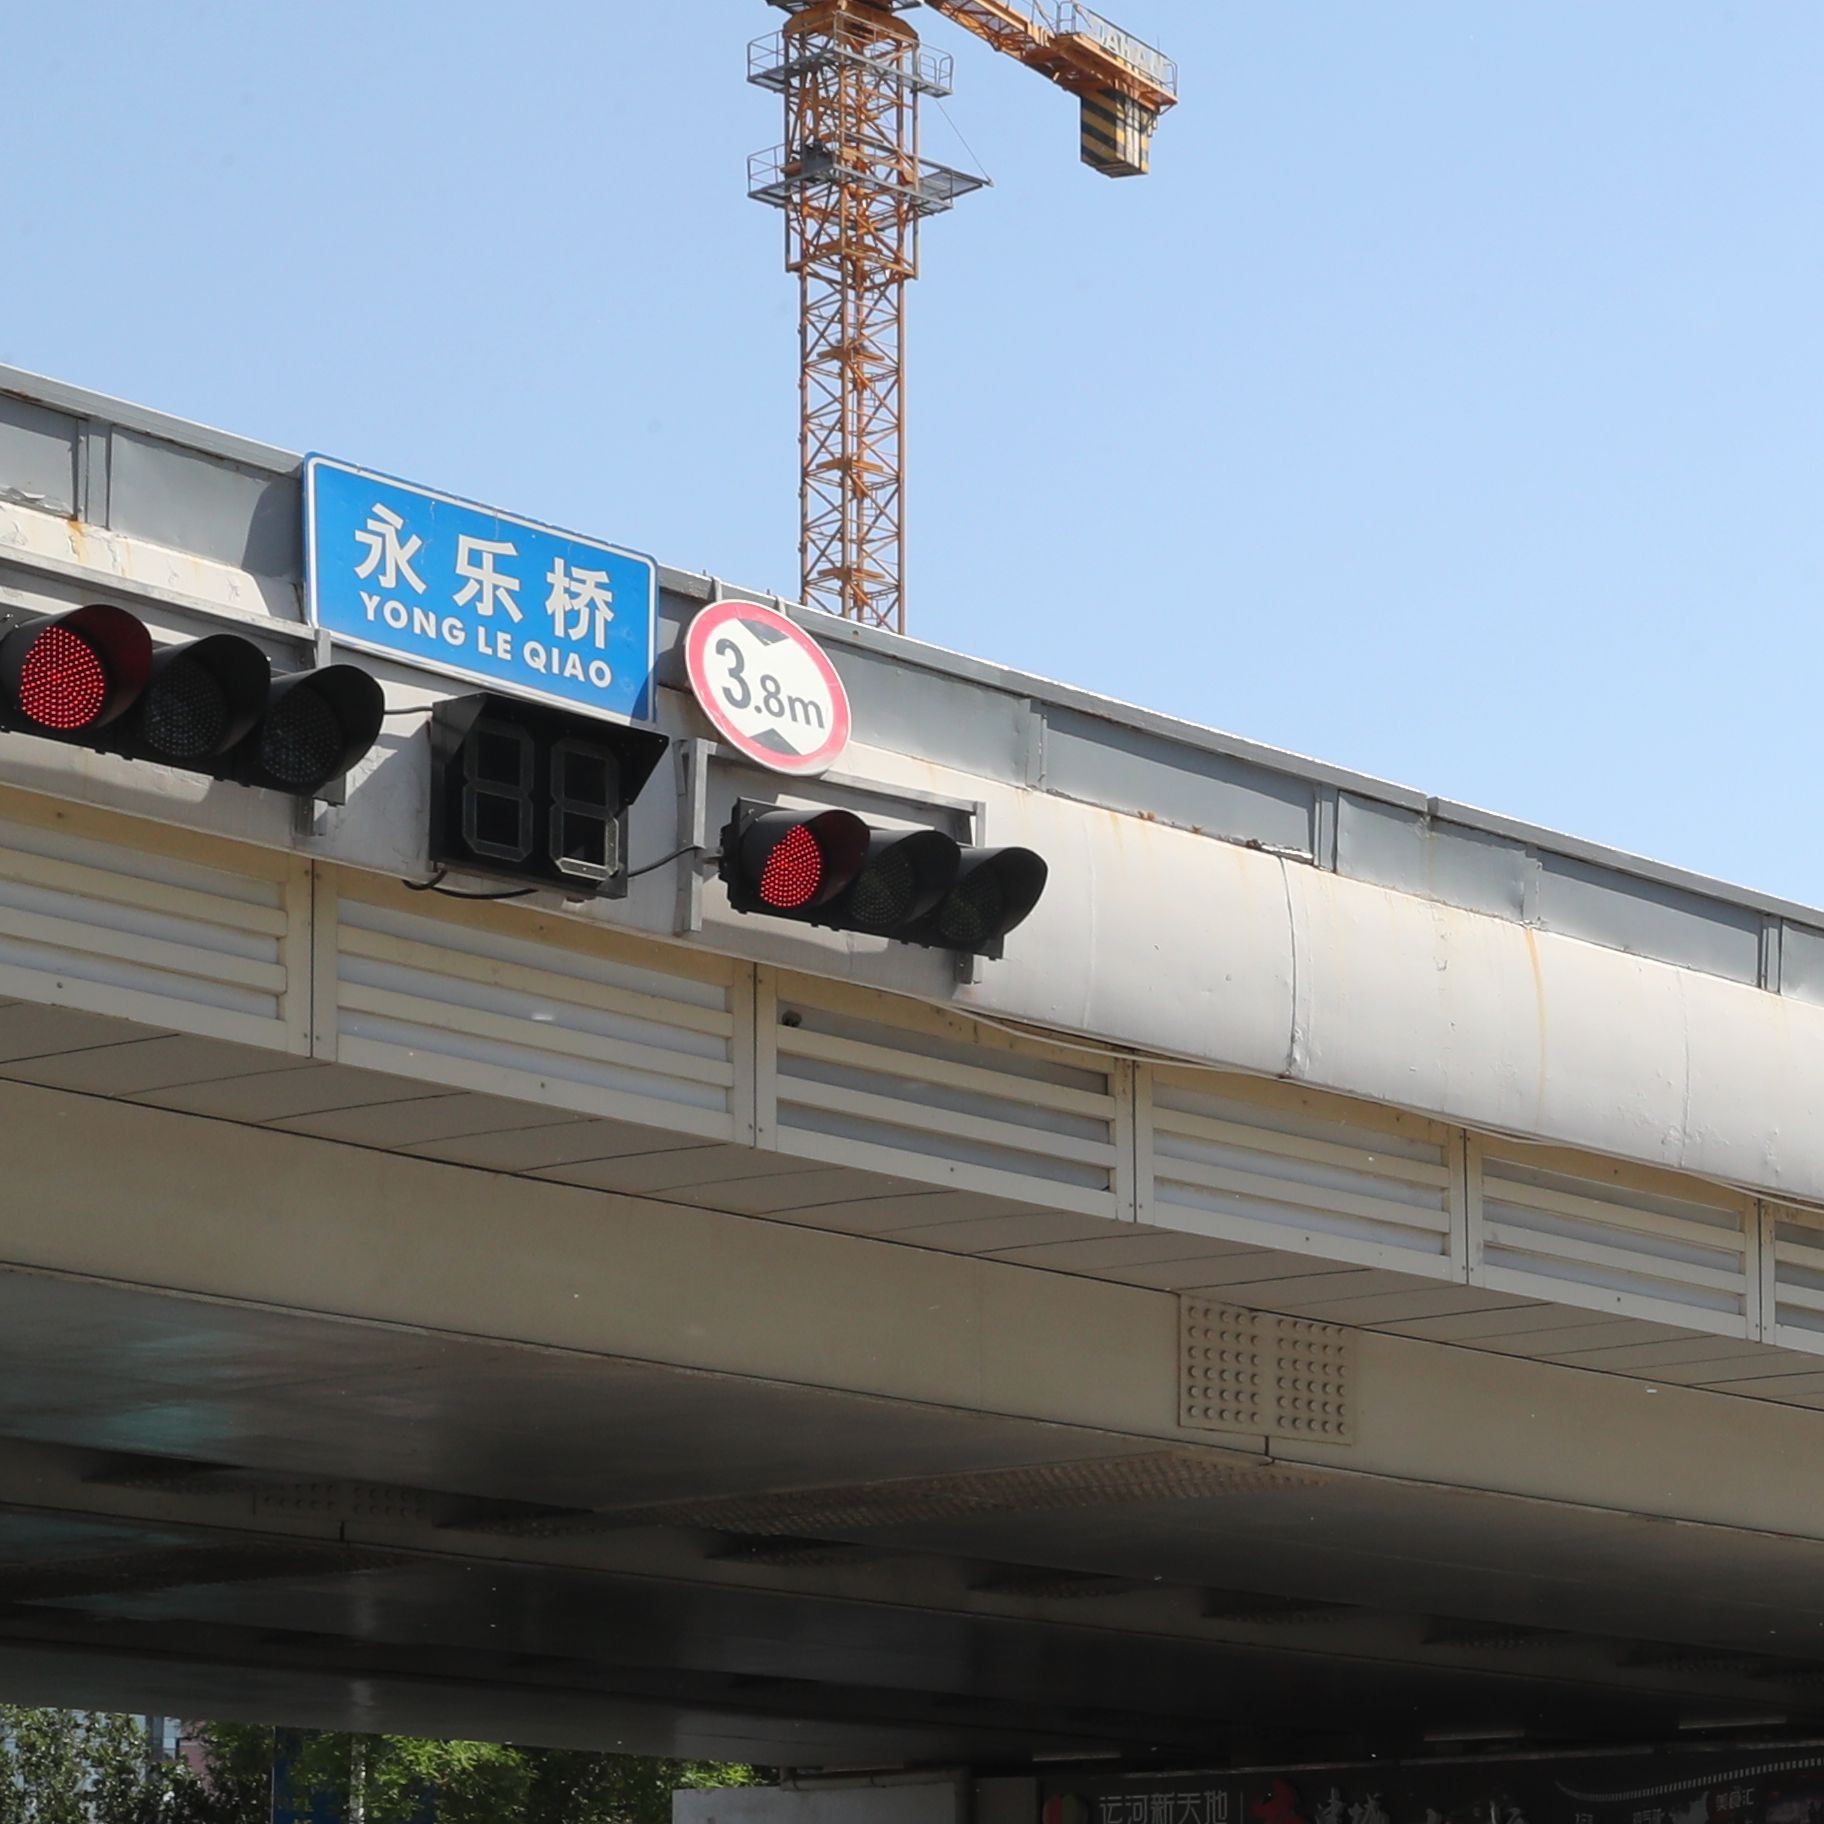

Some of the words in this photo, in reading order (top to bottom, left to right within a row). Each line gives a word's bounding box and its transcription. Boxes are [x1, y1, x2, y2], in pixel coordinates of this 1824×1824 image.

[354, 503, 614, 649] 永乐桥
[359, 591, 466, 646] YONG
[478, 626, 512, 661] LE
[523, 641, 613, 689] QIAO
[715, 638, 825, 729] 3.8m
